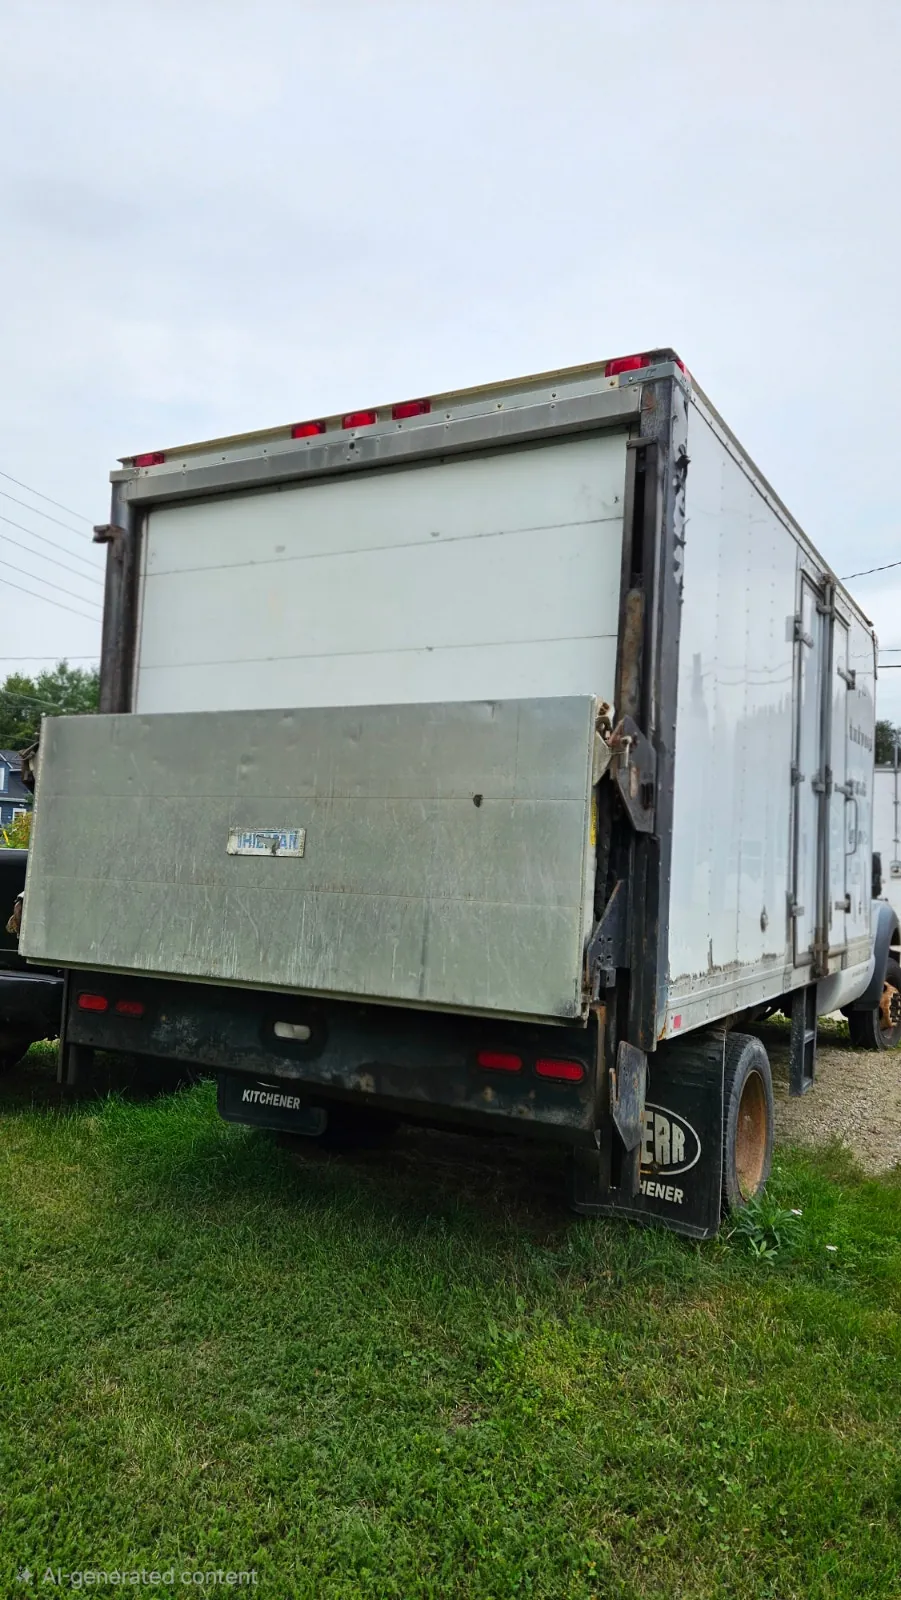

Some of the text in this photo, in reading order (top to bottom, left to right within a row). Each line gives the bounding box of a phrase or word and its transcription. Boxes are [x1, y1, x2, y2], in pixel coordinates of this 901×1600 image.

[242, 1089, 300, 1110] KITCHENER
[640, 1110, 685, 1165] ERR
[639, 1180, 684, 1204] HENER
